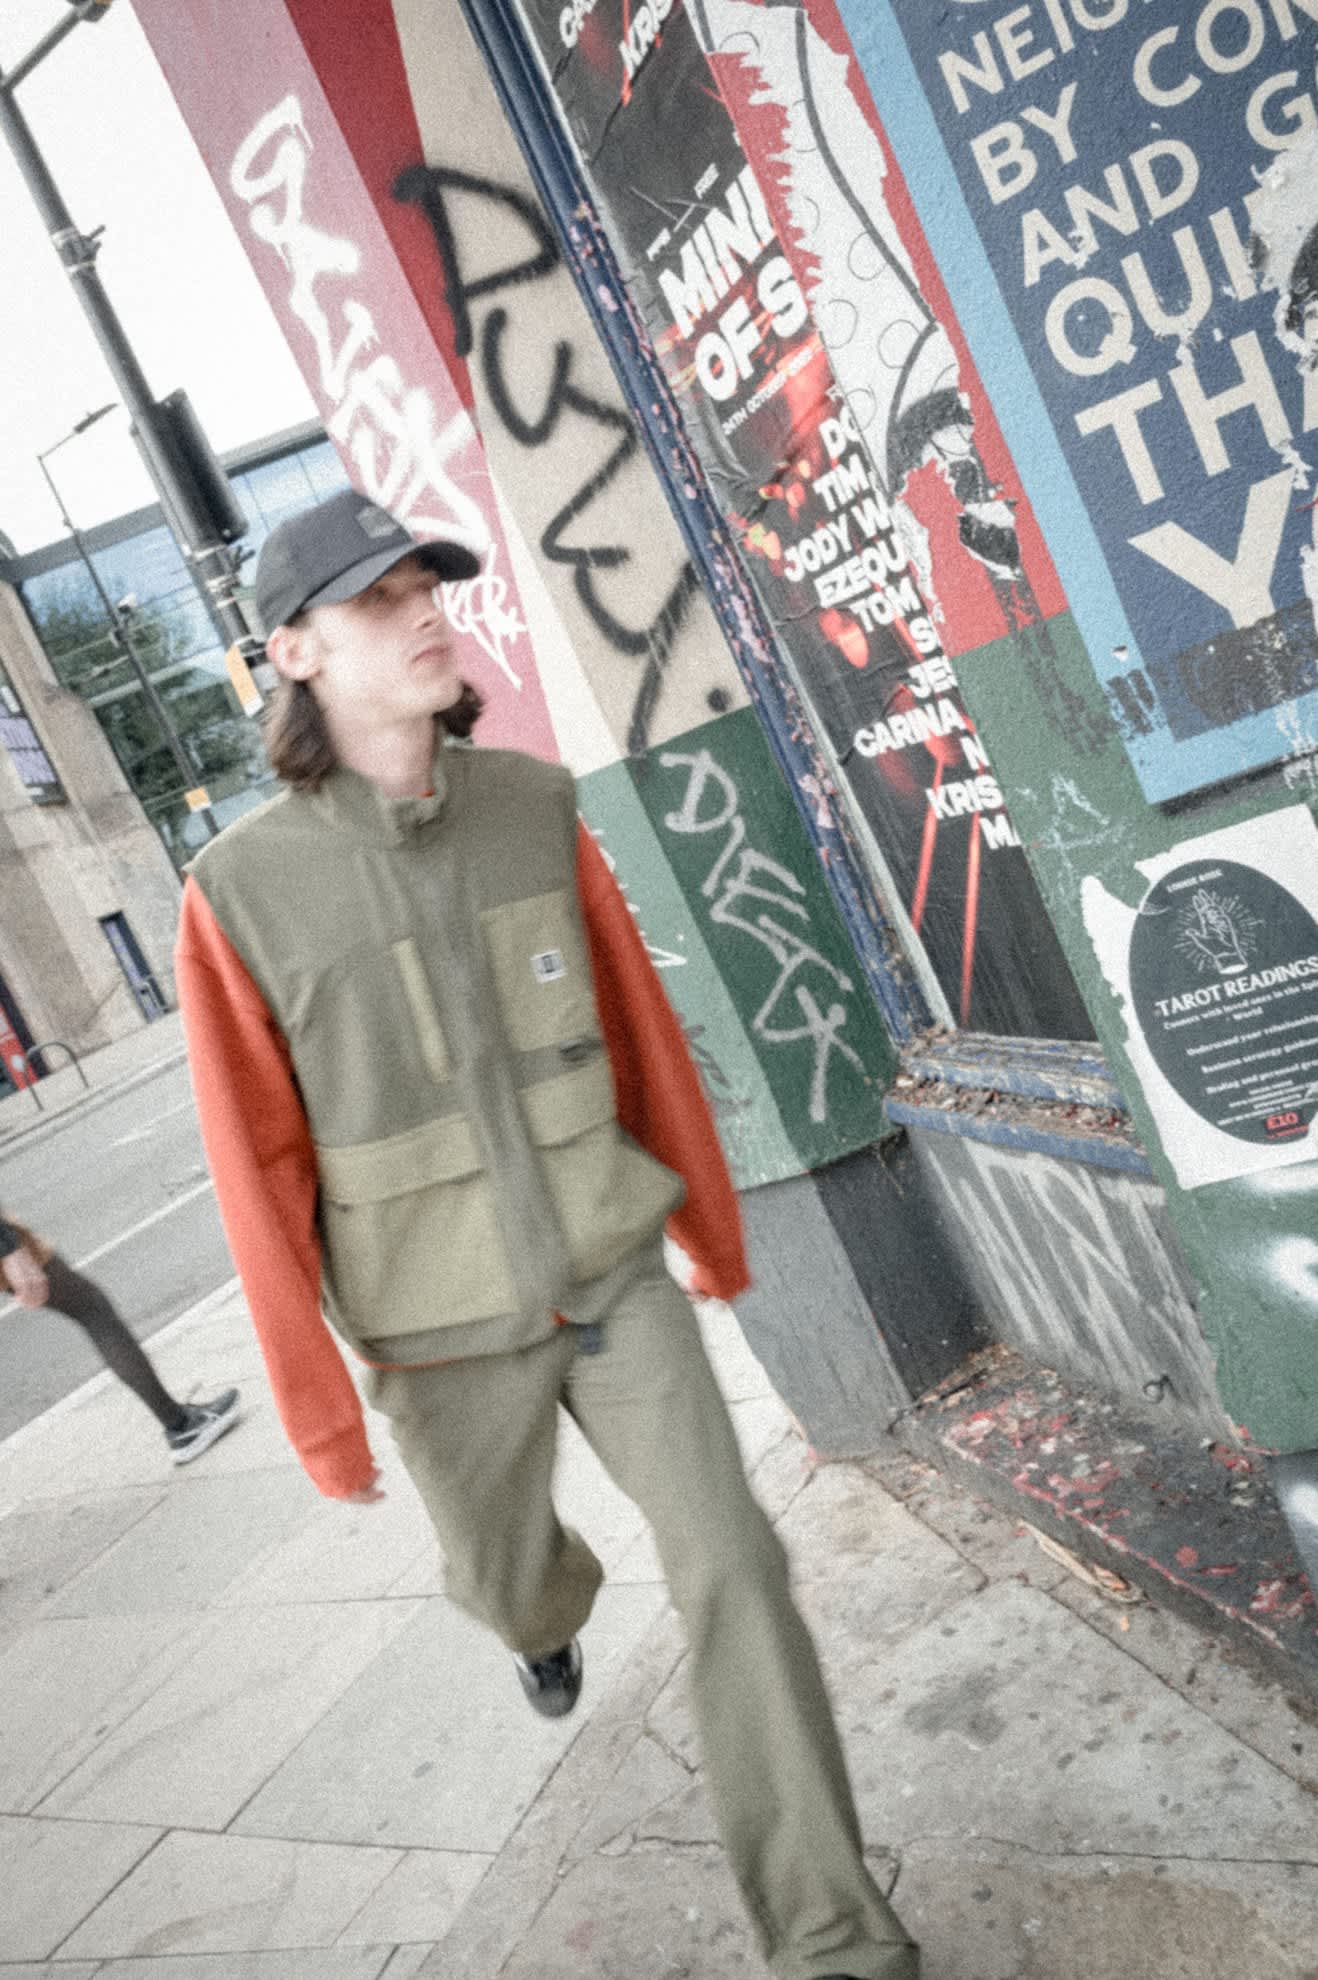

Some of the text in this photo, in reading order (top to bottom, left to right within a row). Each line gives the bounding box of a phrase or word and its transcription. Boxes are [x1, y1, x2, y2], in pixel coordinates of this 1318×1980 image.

[970, 82, 1078, 204] BY
[1022, 139, 1199, 286] AND
[695, 295, 762, 402] OF
[812, 453, 870, 513] TIM
[783, 513, 853, 582] JODY
[849, 577, 922, 634] TOM
[853, 698, 969, 760] CARINA
[926, 775, 1004, 821] KRIS
[1154, 955, 1318, 1017] TAROT READINGS
